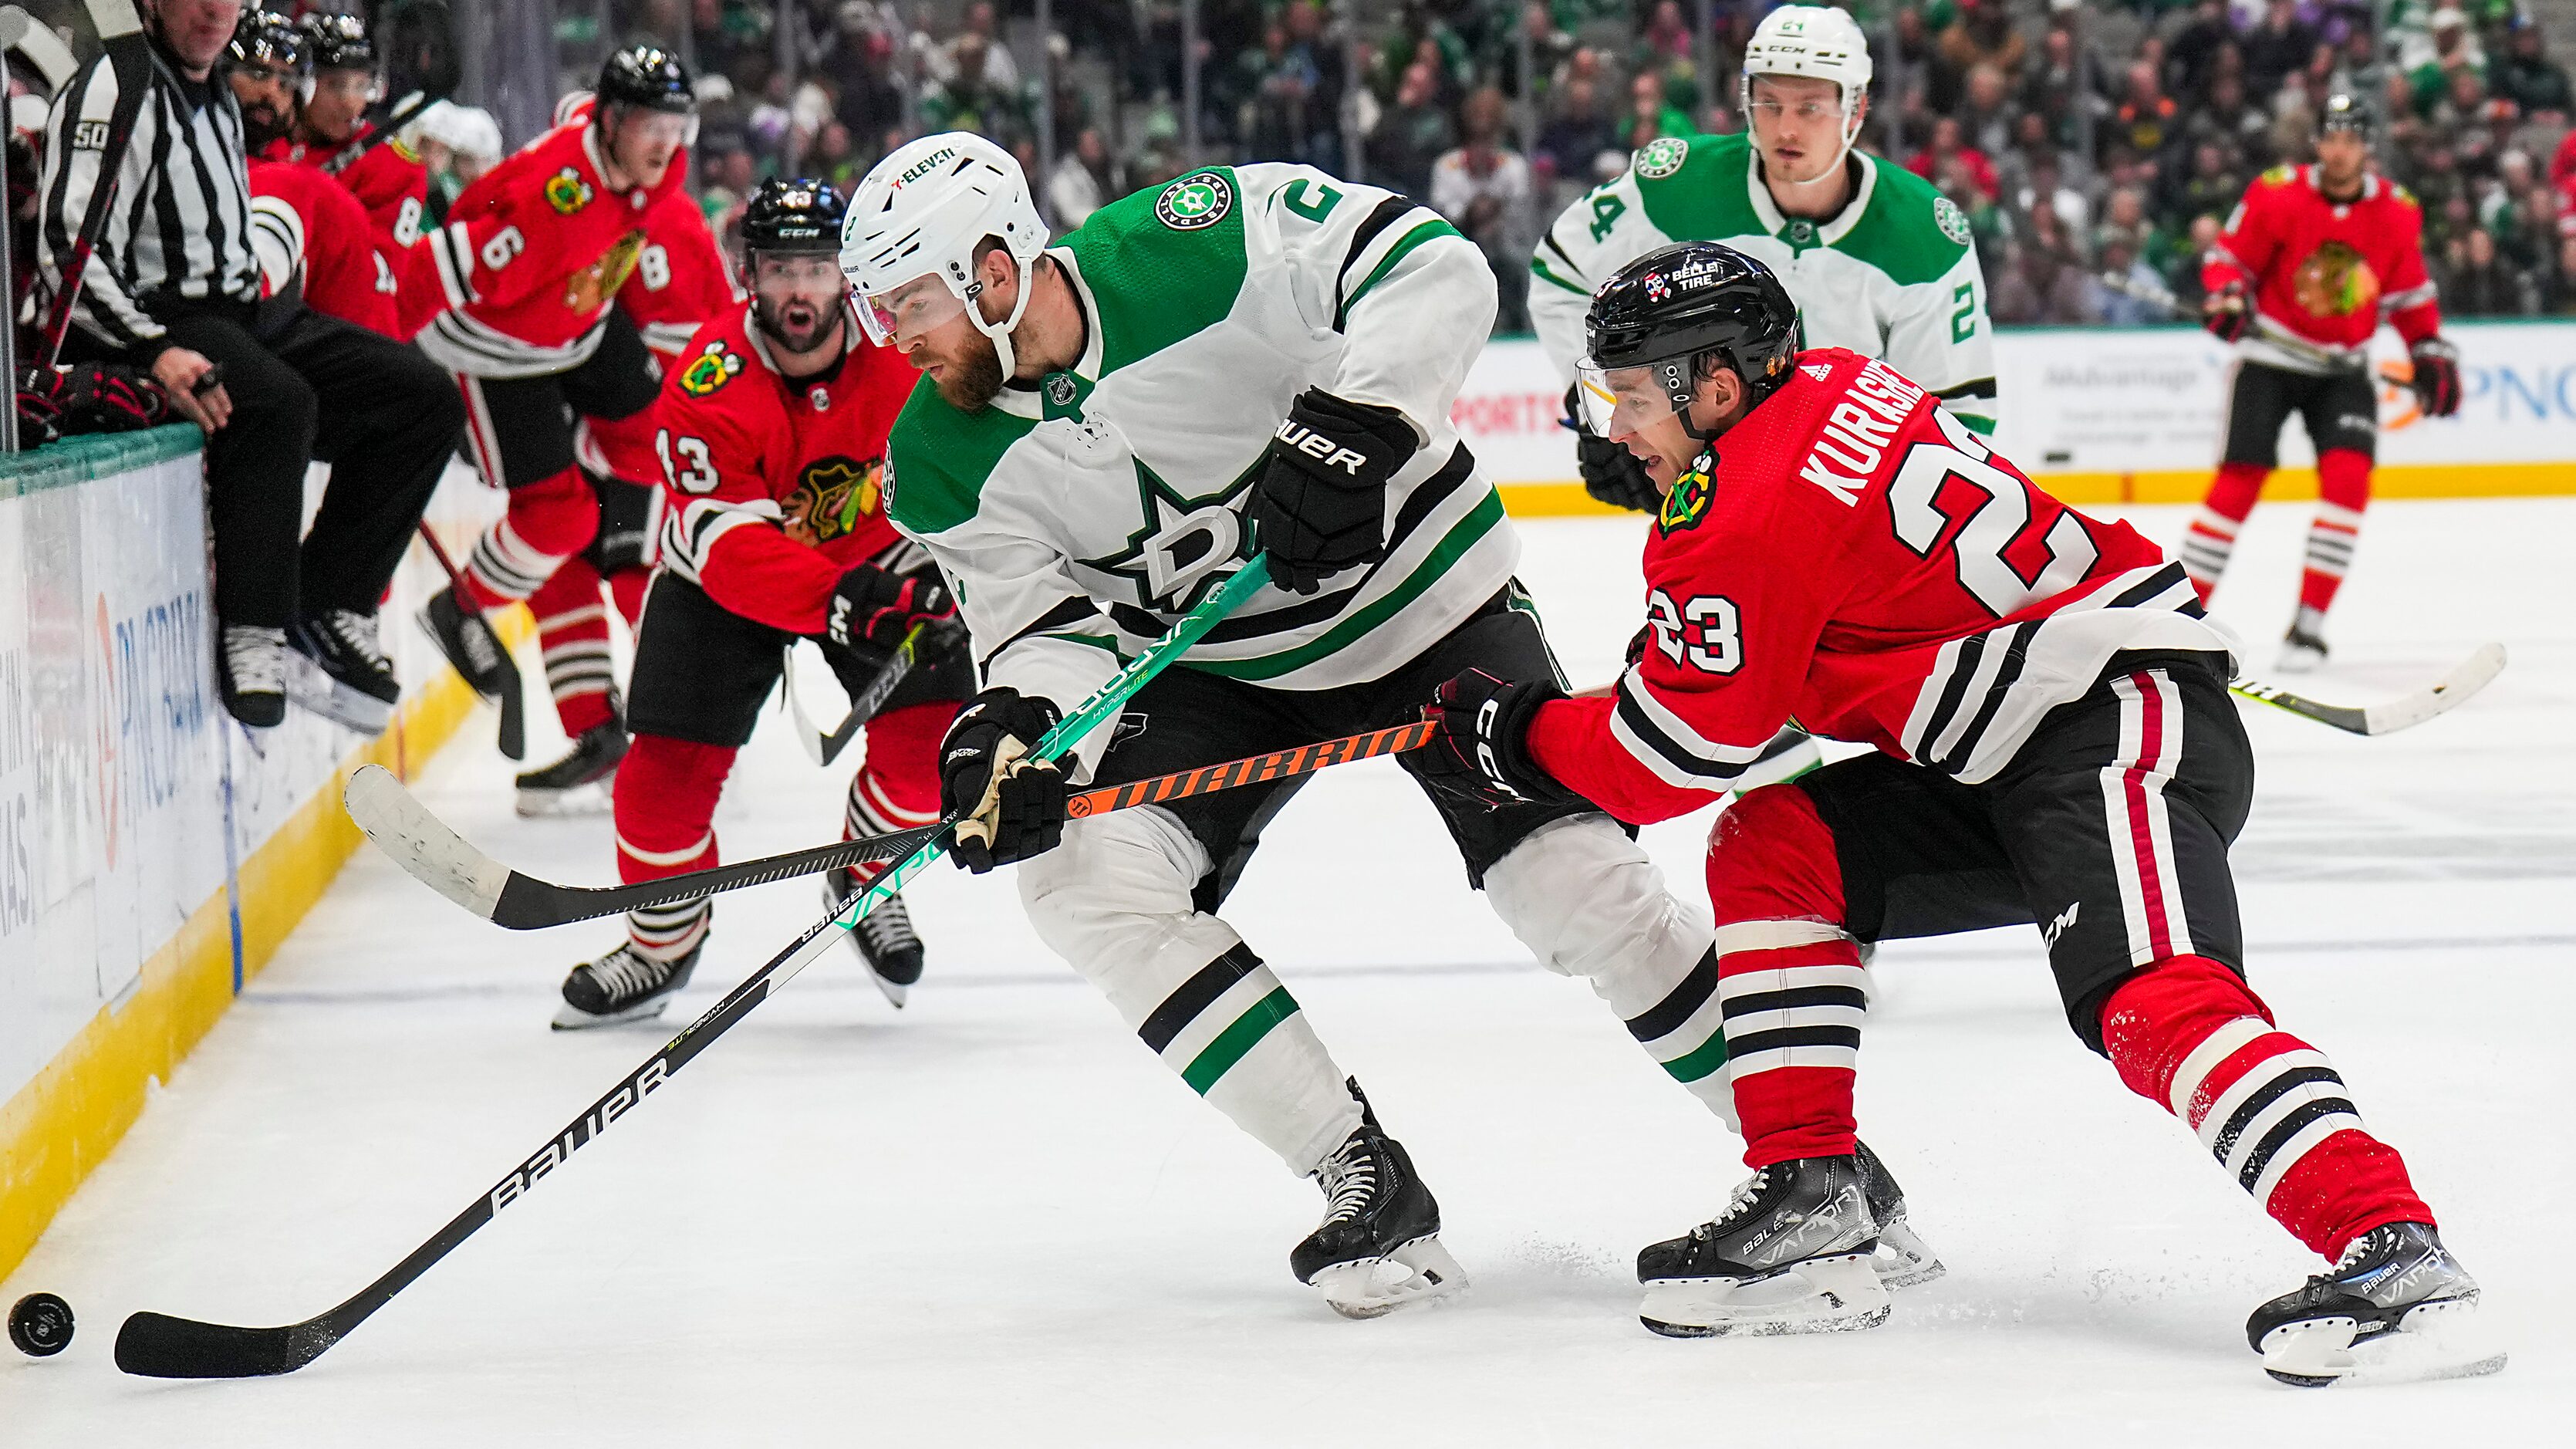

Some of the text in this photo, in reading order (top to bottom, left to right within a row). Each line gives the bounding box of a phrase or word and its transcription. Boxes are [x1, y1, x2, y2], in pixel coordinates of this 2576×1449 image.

[73, 122, 110, 149] 50
[481, 225, 525, 271] 6
[639, 243, 671, 292] 8
[1671, 261, 1719, 282] BELLE
[1679, 273, 1713, 292] TIRE
[1649, 587, 1744, 675] 23
[1092, 668, 1150, 721] HYPERLITE
[800, 887, 865, 944] BAUER
[490, 1057, 670, 1217] BAUER
[2360, 1262, 2402, 1295] BAUER
